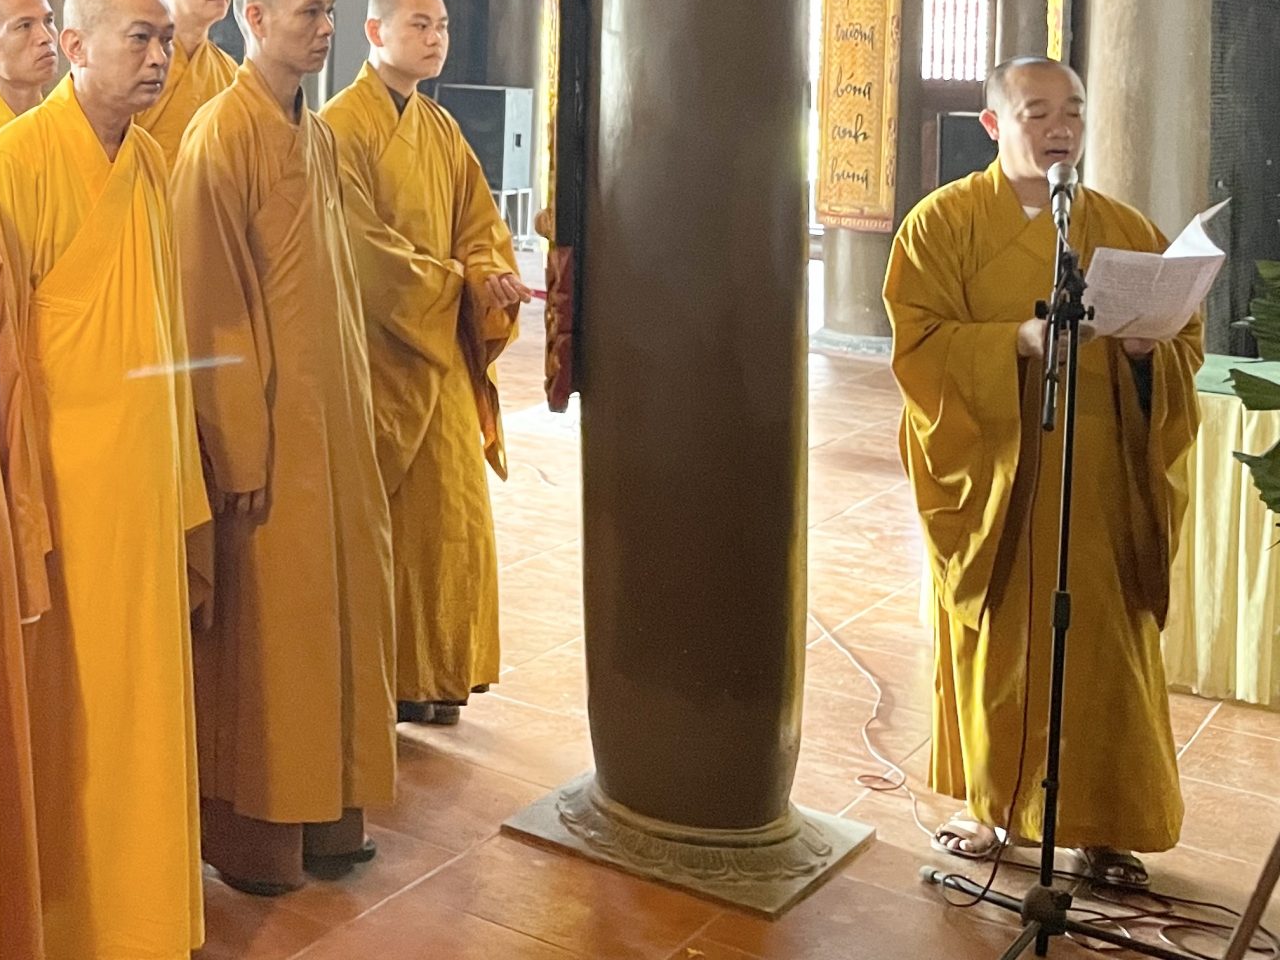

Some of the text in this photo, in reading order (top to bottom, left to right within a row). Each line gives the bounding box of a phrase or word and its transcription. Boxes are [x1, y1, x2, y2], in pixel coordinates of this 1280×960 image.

[835, 22, 876, 51] trượng
[834, 66, 872, 100] bóng
[832, 113, 870, 144] anh
[830, 157, 869, 190] hùng
